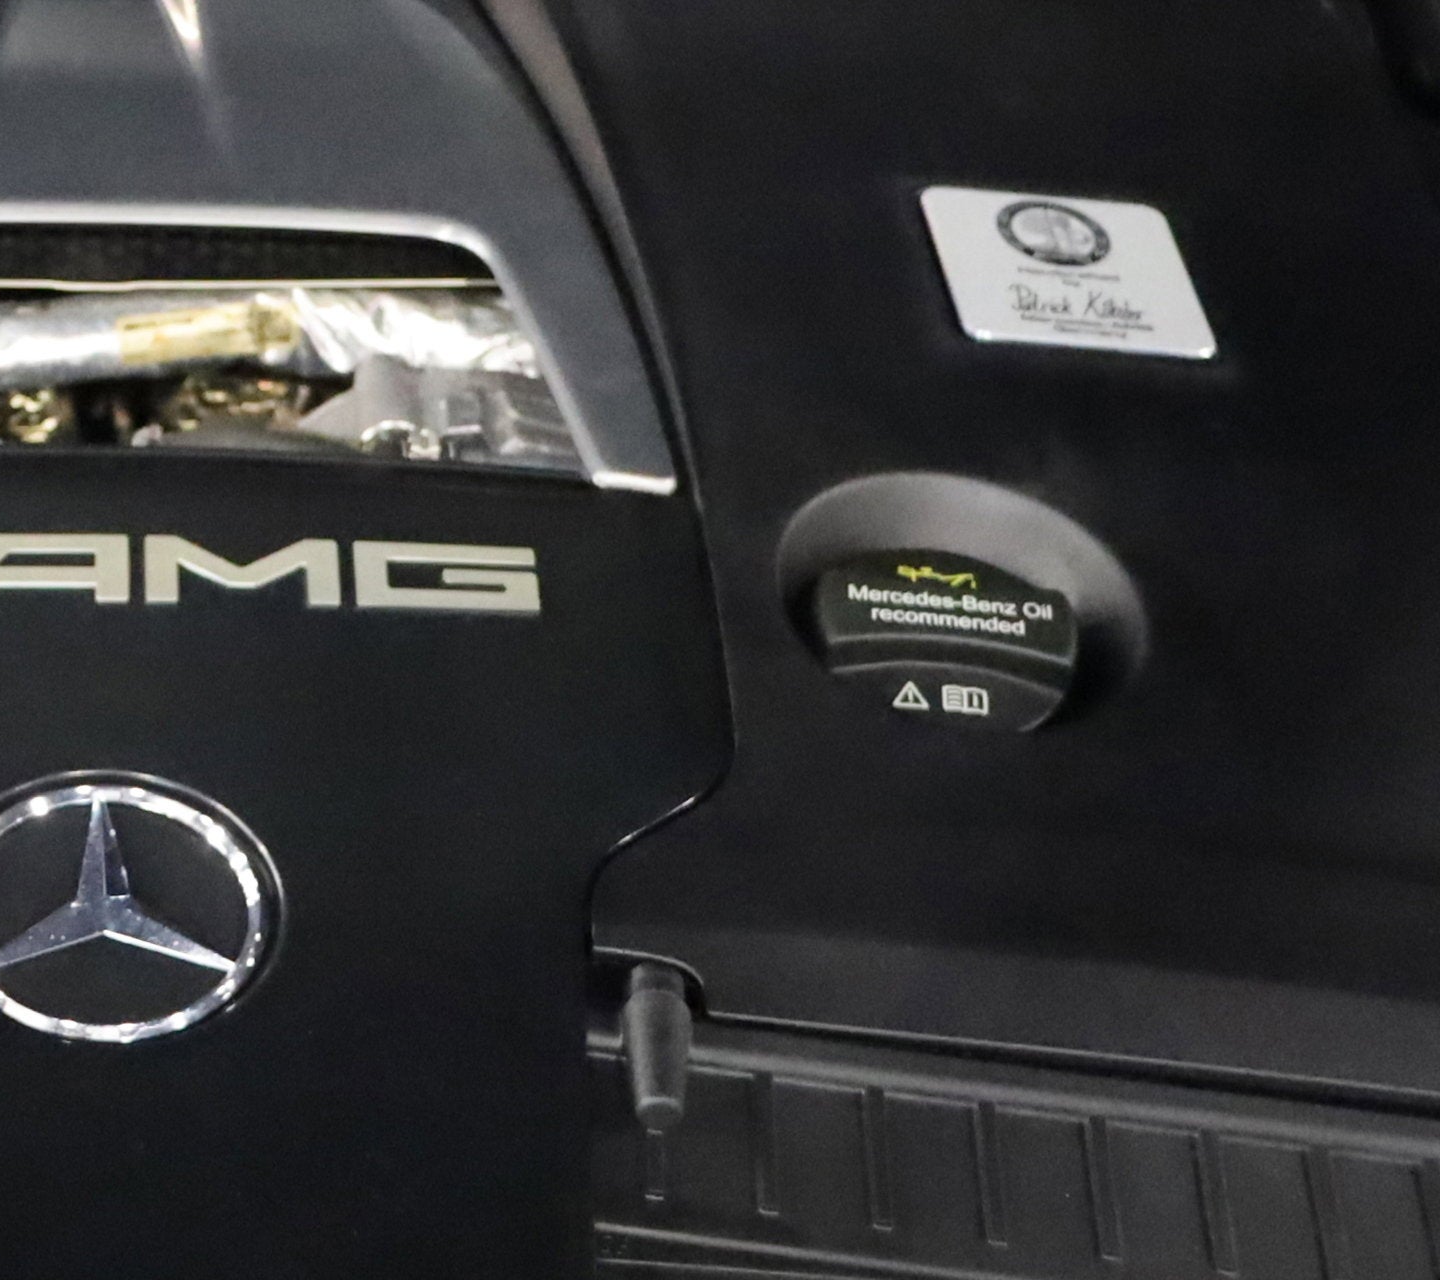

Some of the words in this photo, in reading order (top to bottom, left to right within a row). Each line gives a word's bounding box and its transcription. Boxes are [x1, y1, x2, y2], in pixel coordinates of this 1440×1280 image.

[847, 583, 1017, 616] Mercedes-Benz
[1022, 601, 1053, 620] Oil
[871, 607, 1026, 636] recommended
